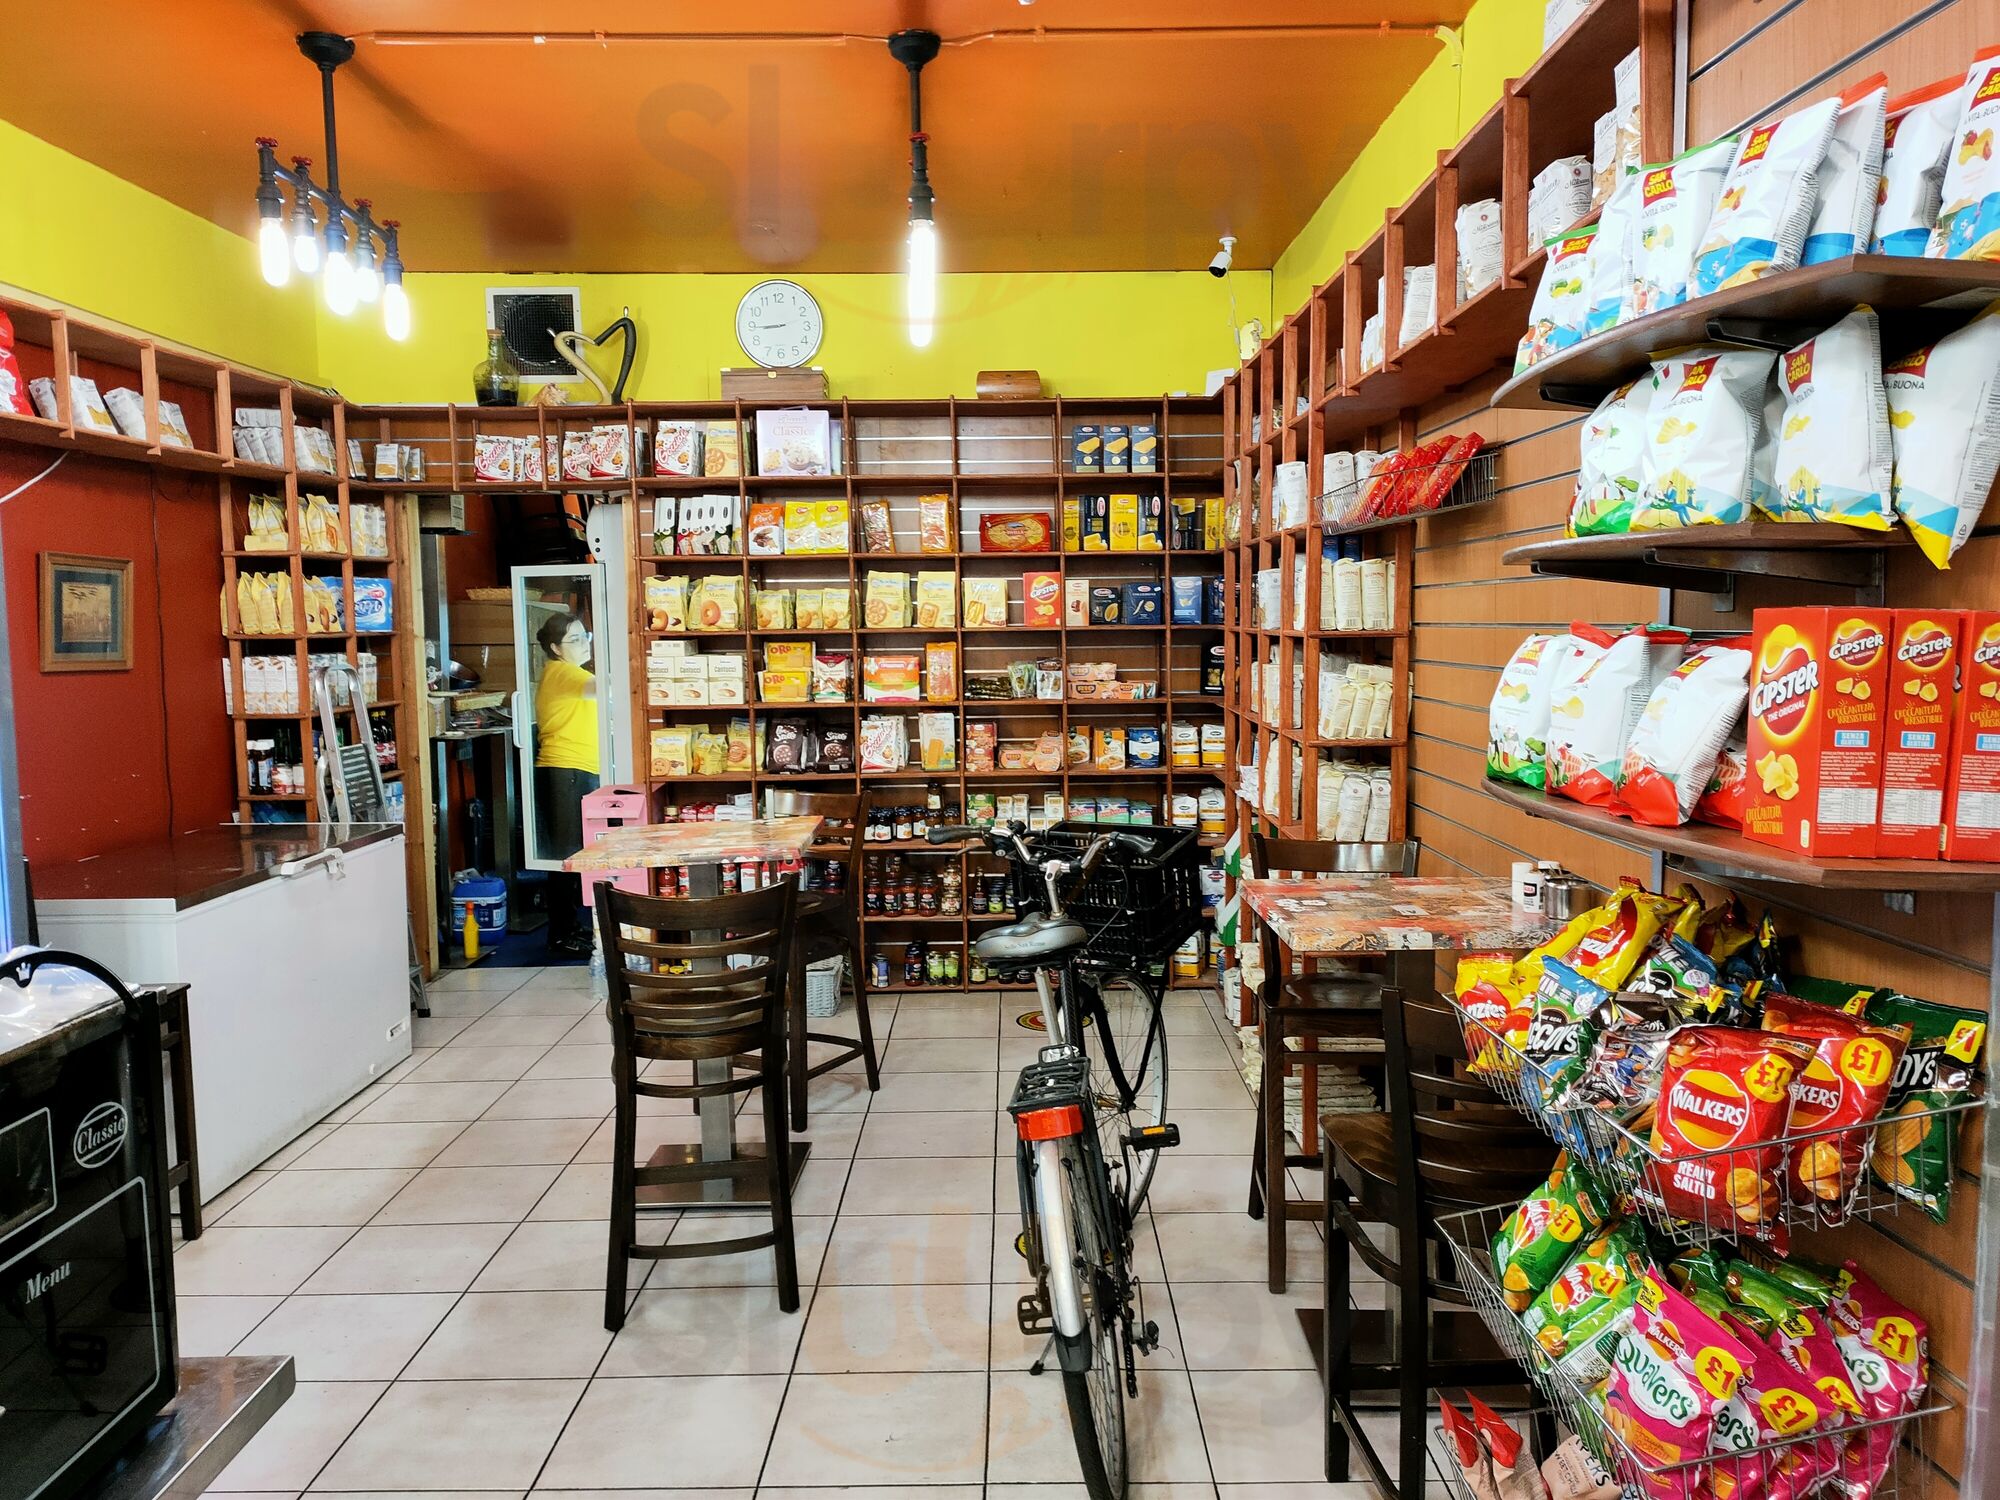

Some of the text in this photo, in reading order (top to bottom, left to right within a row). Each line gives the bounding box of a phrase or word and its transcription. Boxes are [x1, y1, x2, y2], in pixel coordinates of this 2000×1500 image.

[1648, 169, 1670, 187] SAN
[1644, 180, 1674, 199] CARLO
[760, 296, 769, 307] 11
[773, 292, 784, 304] 12
[791, 296, 796, 305] 1
[750, 306, 762, 318] 10
[799, 306, 807, 317] 2
[748, 321, 756, 332] 9
[803, 321, 811, 332] 3
[752, 335, 760, 346] 8
[800, 335, 808, 345] 4
[764, 346, 772, 357] 7
[777, 348, 785, 359] 6
[791, 345, 800, 356] 5
[1791, 352, 1807, 370] SAN
[1688, 365, 1705, 377] AN
[1787, 364, 1811, 384] CARLO
[1892, 380, 1926, 390] BUONA
[1829, 632, 1885, 661] CIPSTER
[1897, 635, 1953, 662] CIPSTER
[1750, 660, 1819, 718] CIPSTER
[1767, 700, 1806, 723] THE ORIGINAL
[1956, 1026, 1978, 1054] £1
[1848, 1043, 1884, 1078] £1
[1754, 1060, 1787, 1091] £1
[1795, 1082, 1840, 1110] KERS
[1671, 1084, 1746, 1128] WALKERS
[76, 1113, 127, 1156] Classic
[1553, 1208, 1575, 1236] £1
[25, 1261, 72, 1305] Menu
[1877, 1322, 1911, 1359] £1
[1615, 1336, 1694, 1421] Quavers
[1704, 1355, 1736, 1394] £1
[1768, 1394, 1810, 1430] £1
